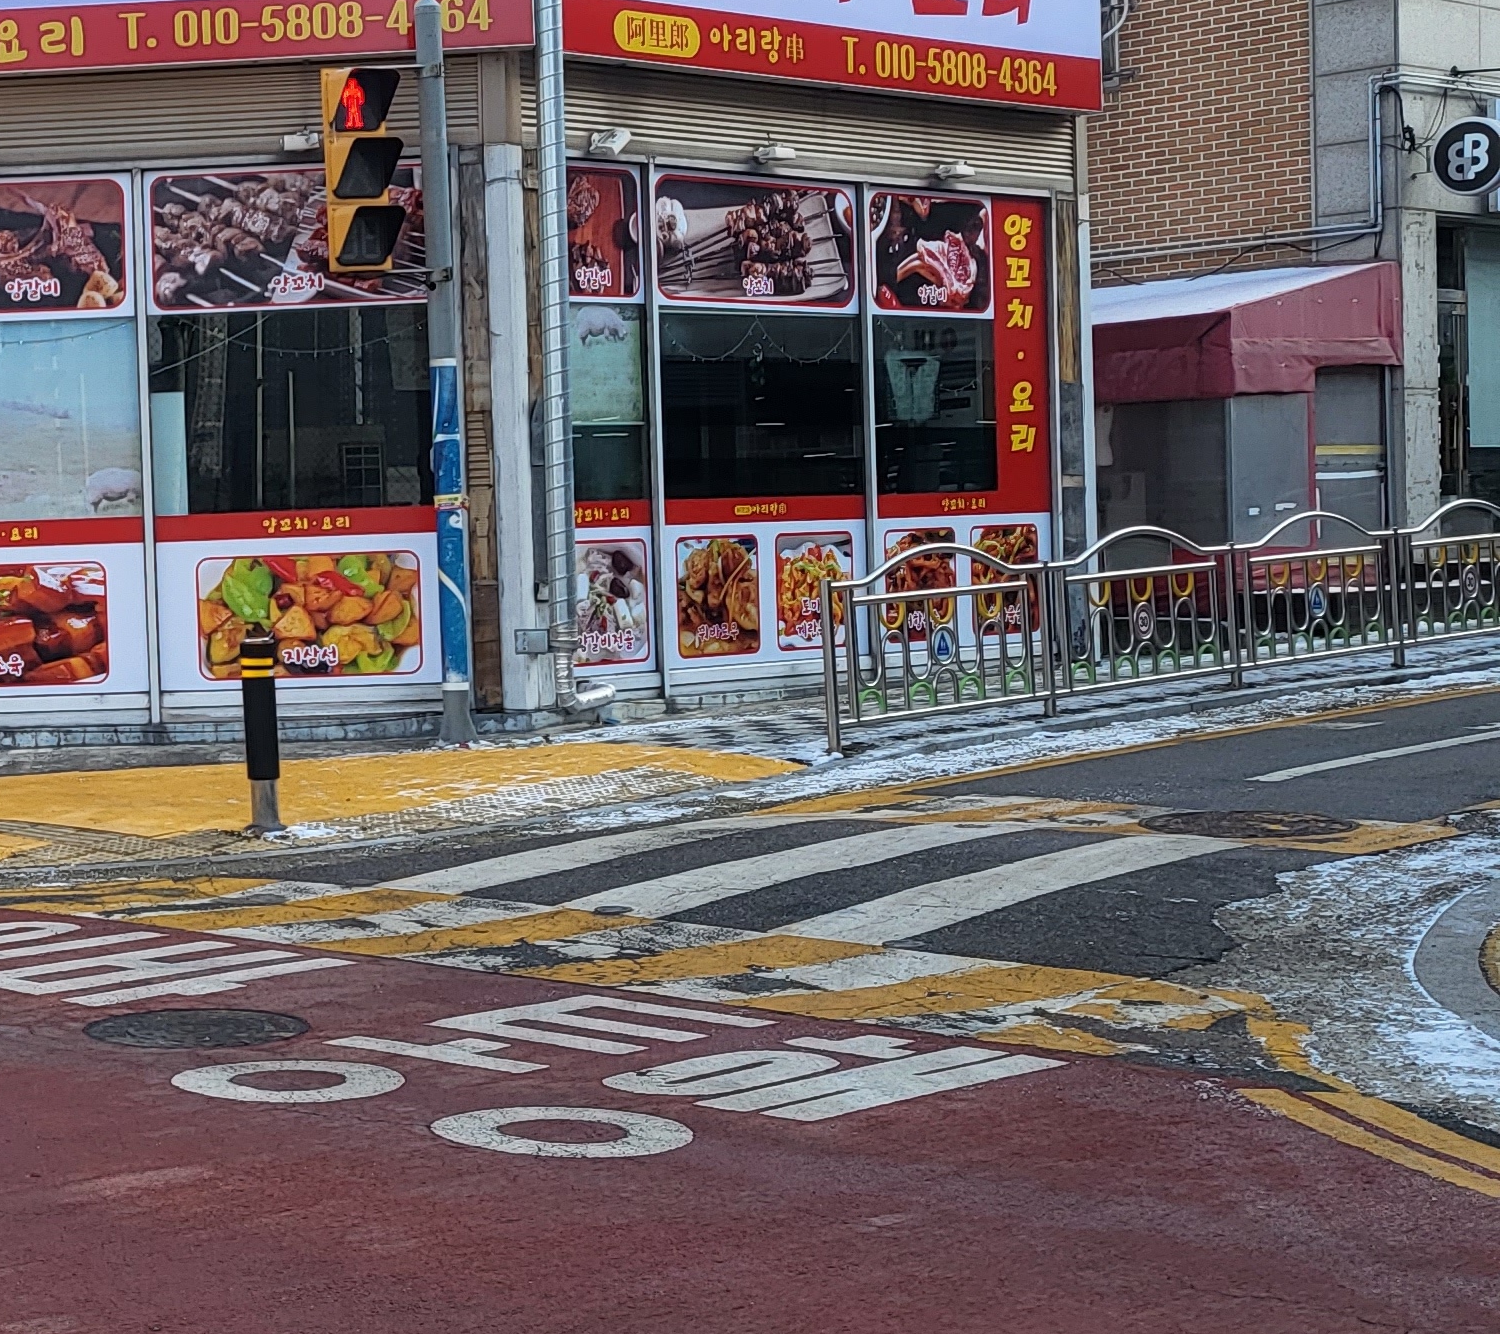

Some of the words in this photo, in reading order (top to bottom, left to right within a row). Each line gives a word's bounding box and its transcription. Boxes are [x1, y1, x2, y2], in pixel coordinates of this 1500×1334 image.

[626, 14, 691, 51] 阿里郎
[876, 39, 1058, 97] 010-5808-4364
[272, 273, 325, 294] 양꼬치
[575, 266, 612, 289] 양갈비
[742, 275, 774, 297] 양꼬치
[4, 277, 61, 301] 양갈비
[917, 284, 948, 306] 양갈비
